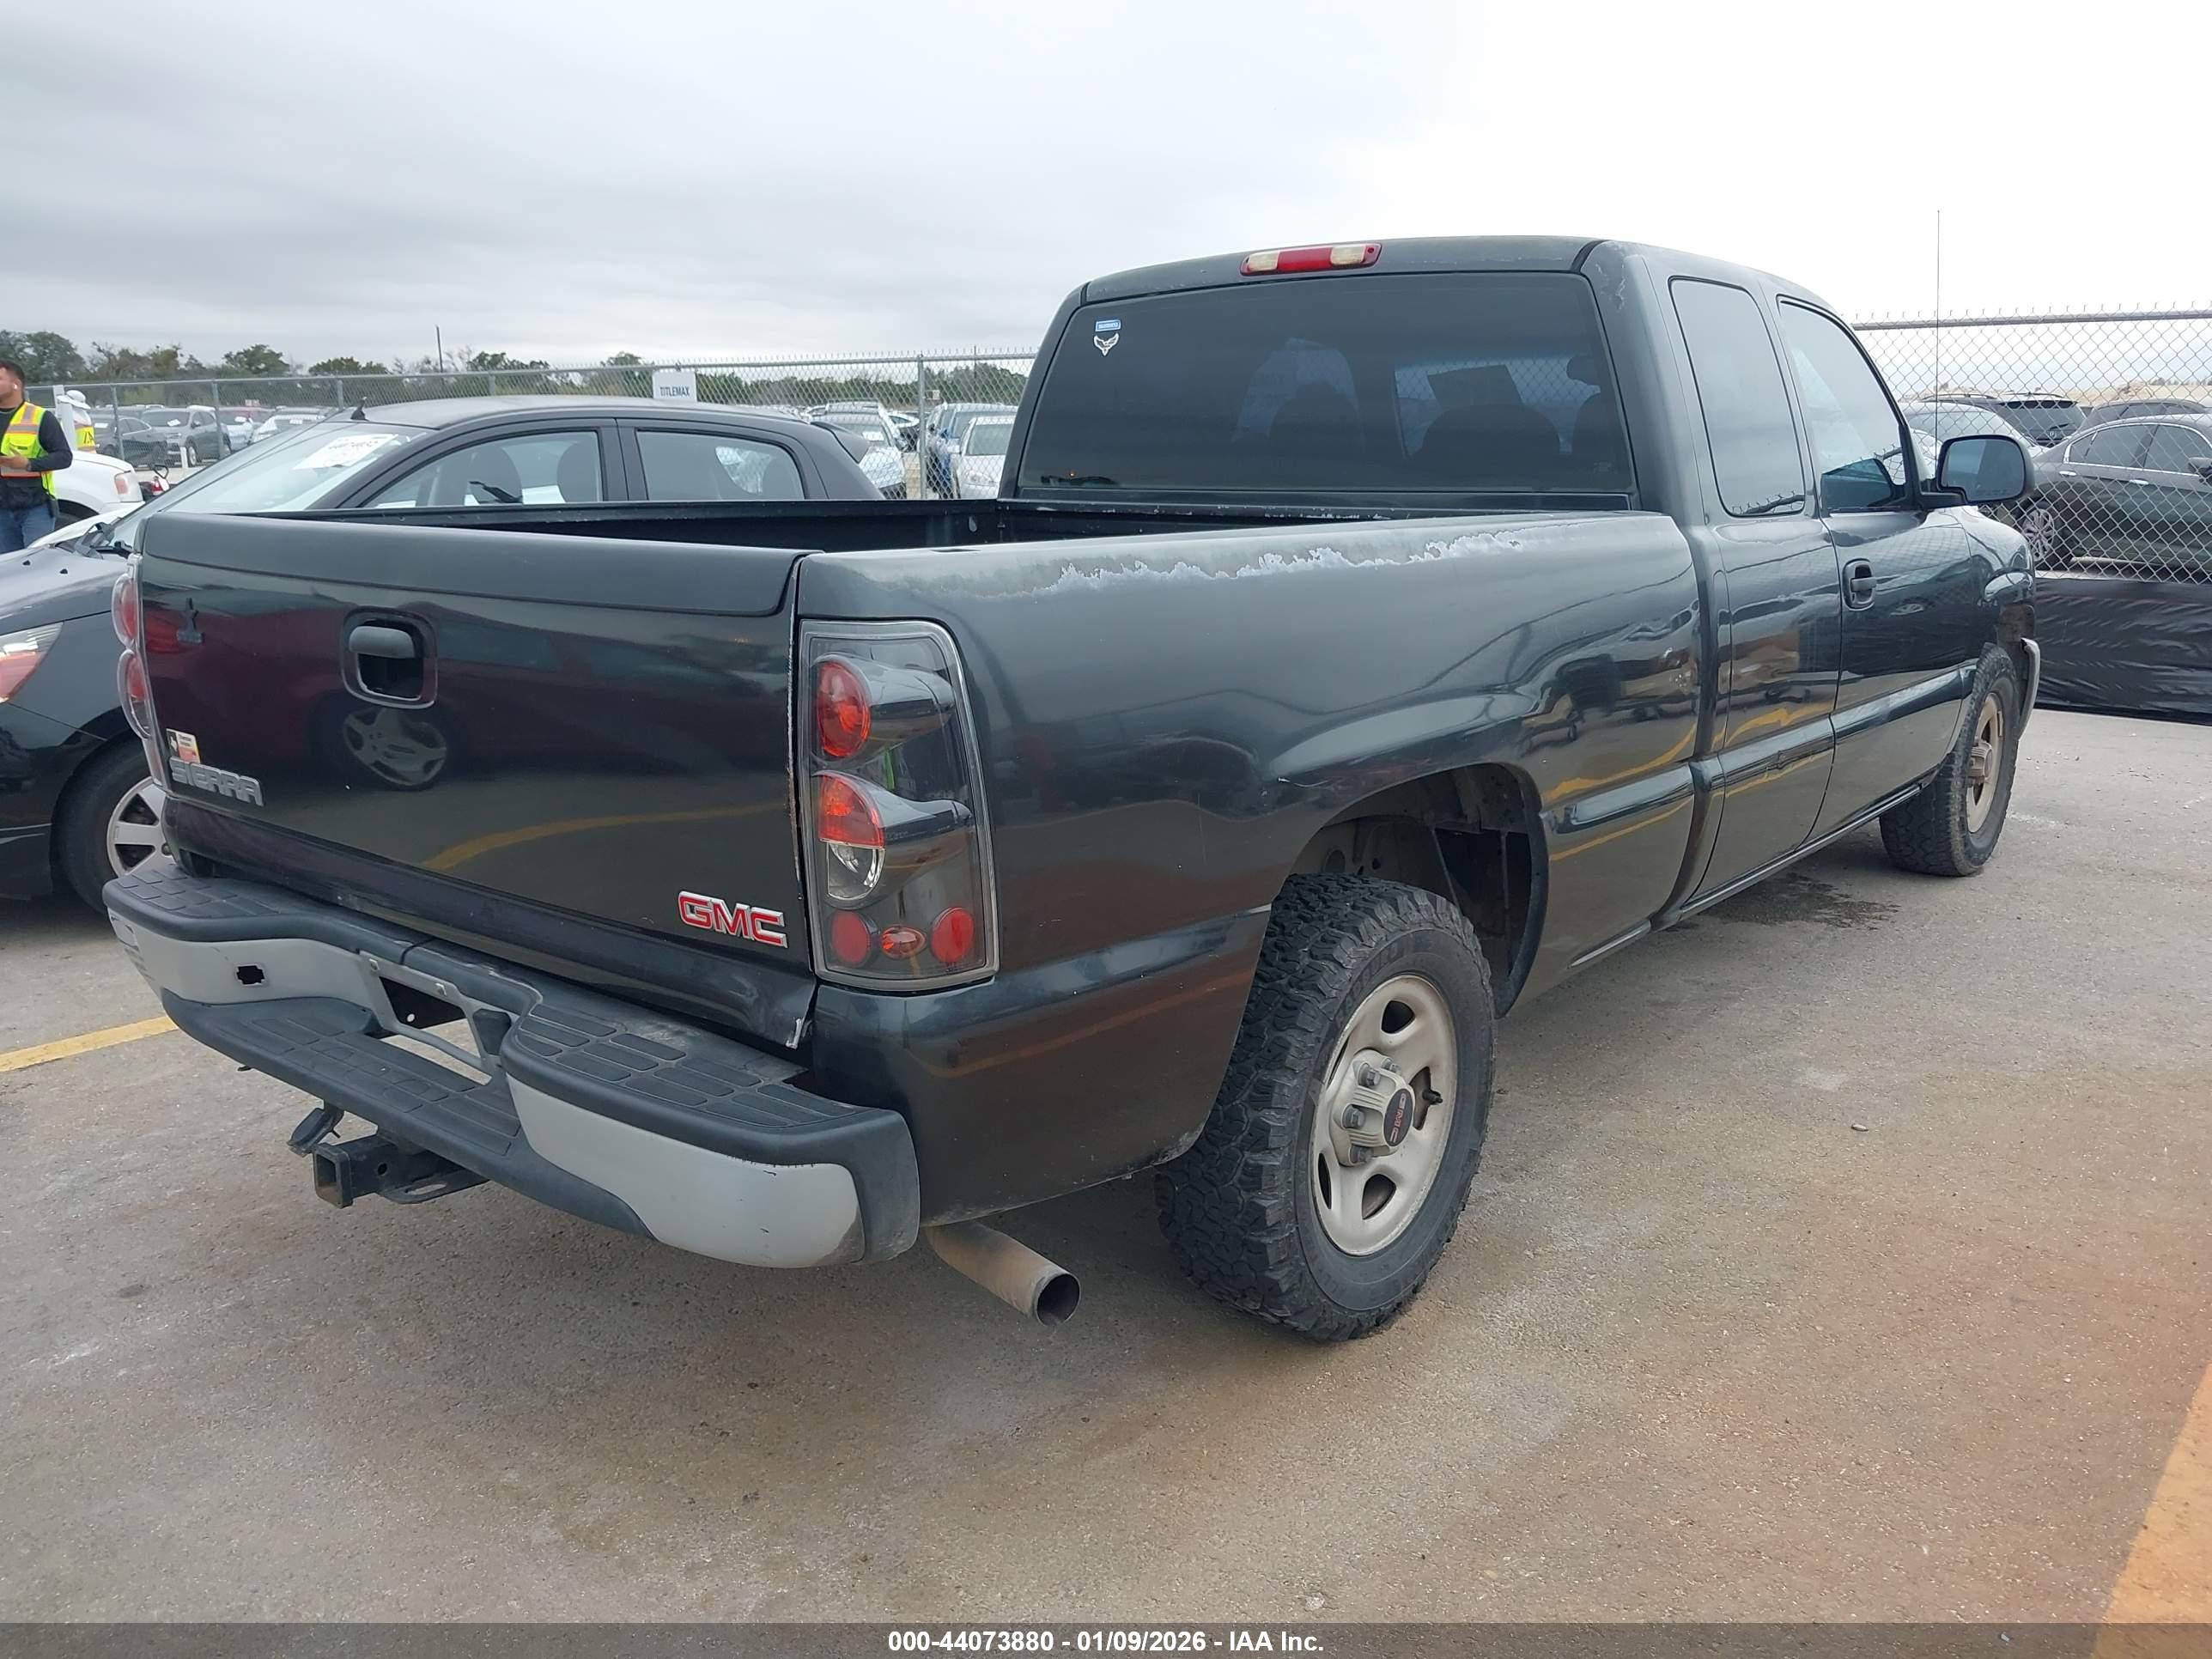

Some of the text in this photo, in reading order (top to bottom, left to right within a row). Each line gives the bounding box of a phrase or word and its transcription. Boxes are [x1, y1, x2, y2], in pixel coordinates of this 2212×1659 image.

[659, 386, 690, 397] TITLEMAX
[169, 756, 264, 807] SIERRA
[678, 890, 788, 949] GMC
[1389, 1092, 1407, 1143] GMC
